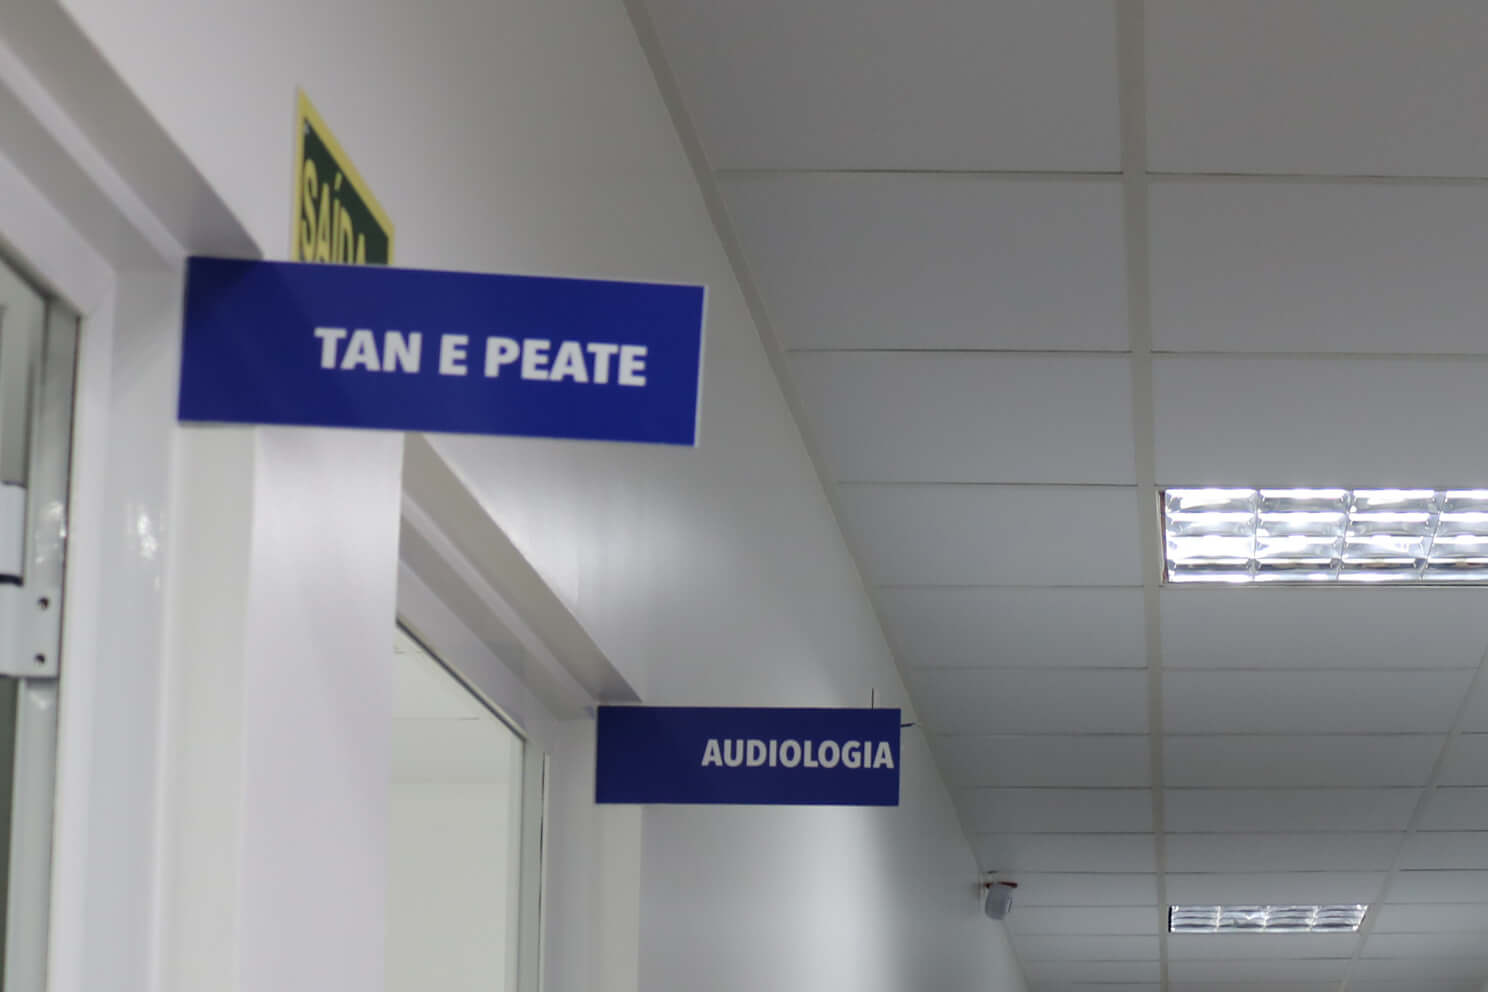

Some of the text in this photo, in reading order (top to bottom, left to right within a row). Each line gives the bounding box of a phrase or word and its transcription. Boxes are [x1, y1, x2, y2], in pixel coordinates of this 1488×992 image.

[314, 327, 648, 387] TAN E PEATE
[701, 738, 895, 769] AUDIOLOGIA
